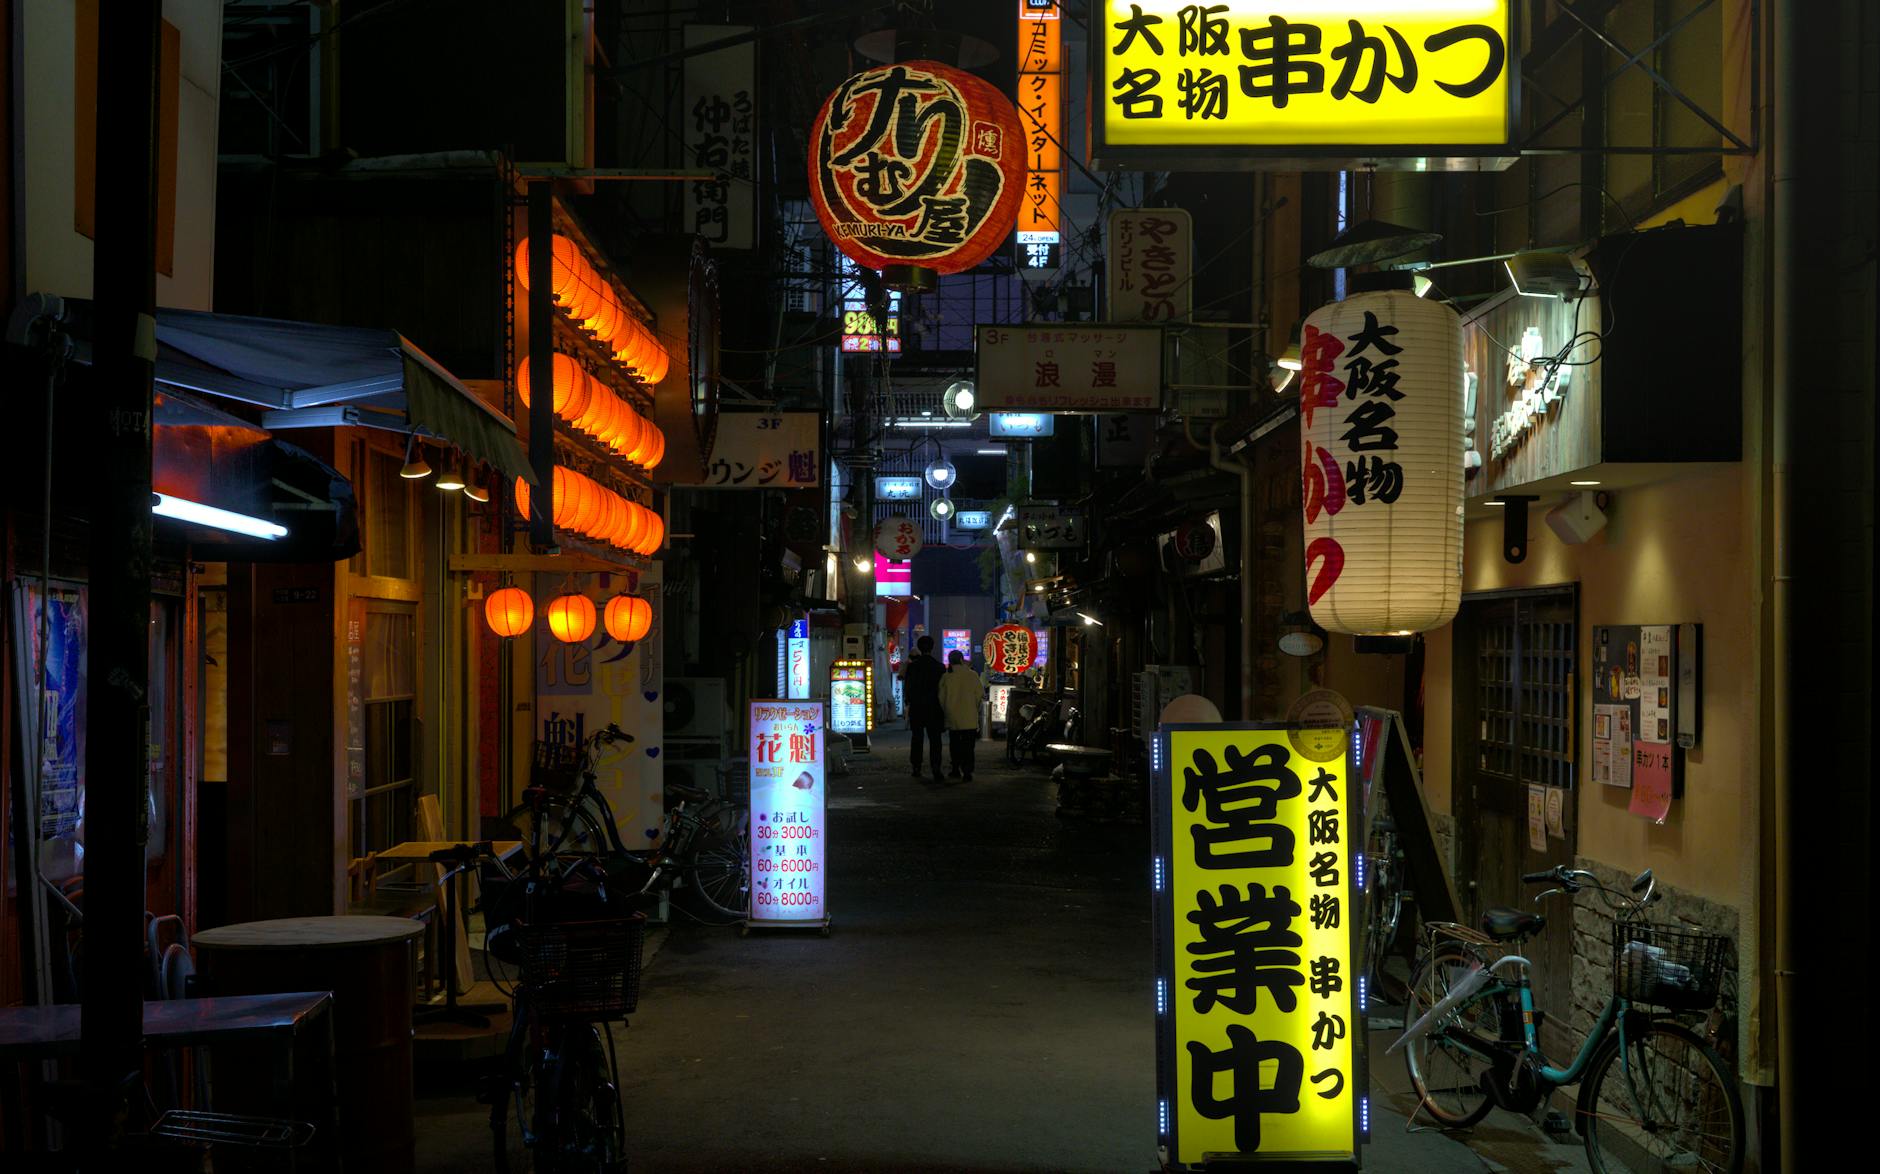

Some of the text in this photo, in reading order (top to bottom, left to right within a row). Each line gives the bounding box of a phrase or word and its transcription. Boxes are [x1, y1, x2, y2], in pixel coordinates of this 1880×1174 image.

[1113, 4, 1231, 58] 大阪
[1238, 15, 1507, 110] 串かつ
[1112, 67, 1229, 120] 名物
[1030, 22, 1048, 224] コミック・インターネット
[833, 222, 906, 239] KEMURI-YA
[1028, 256, 1049, 268] 4F
[985, 329, 1009, 345] 3F
[1035, 361, 1118, 389] 浪漫
[1340, 311, 1407, 505] 大阪名物
[756, 418, 784, 430] 3F
[704, 458, 783, 485] ウンジ
[1301, 323, 1347, 606] 串かつ
[754, 706, 820, 721] リラクゼーション
[756, 732, 818, 763] 花魁
[772, 811, 809, 824] お試し
[757, 825, 819, 839] 30分 3000円
[1307, 766, 1340, 930] 大阪名物
[757, 858, 819, 872] 60分 6000円
[773, 877, 808, 890] オイル
[757, 892, 819, 906] 60分 8000円
[1181, 743, 1306, 1153] 営業中
[1309, 955, 1346, 1100] 串かつ
